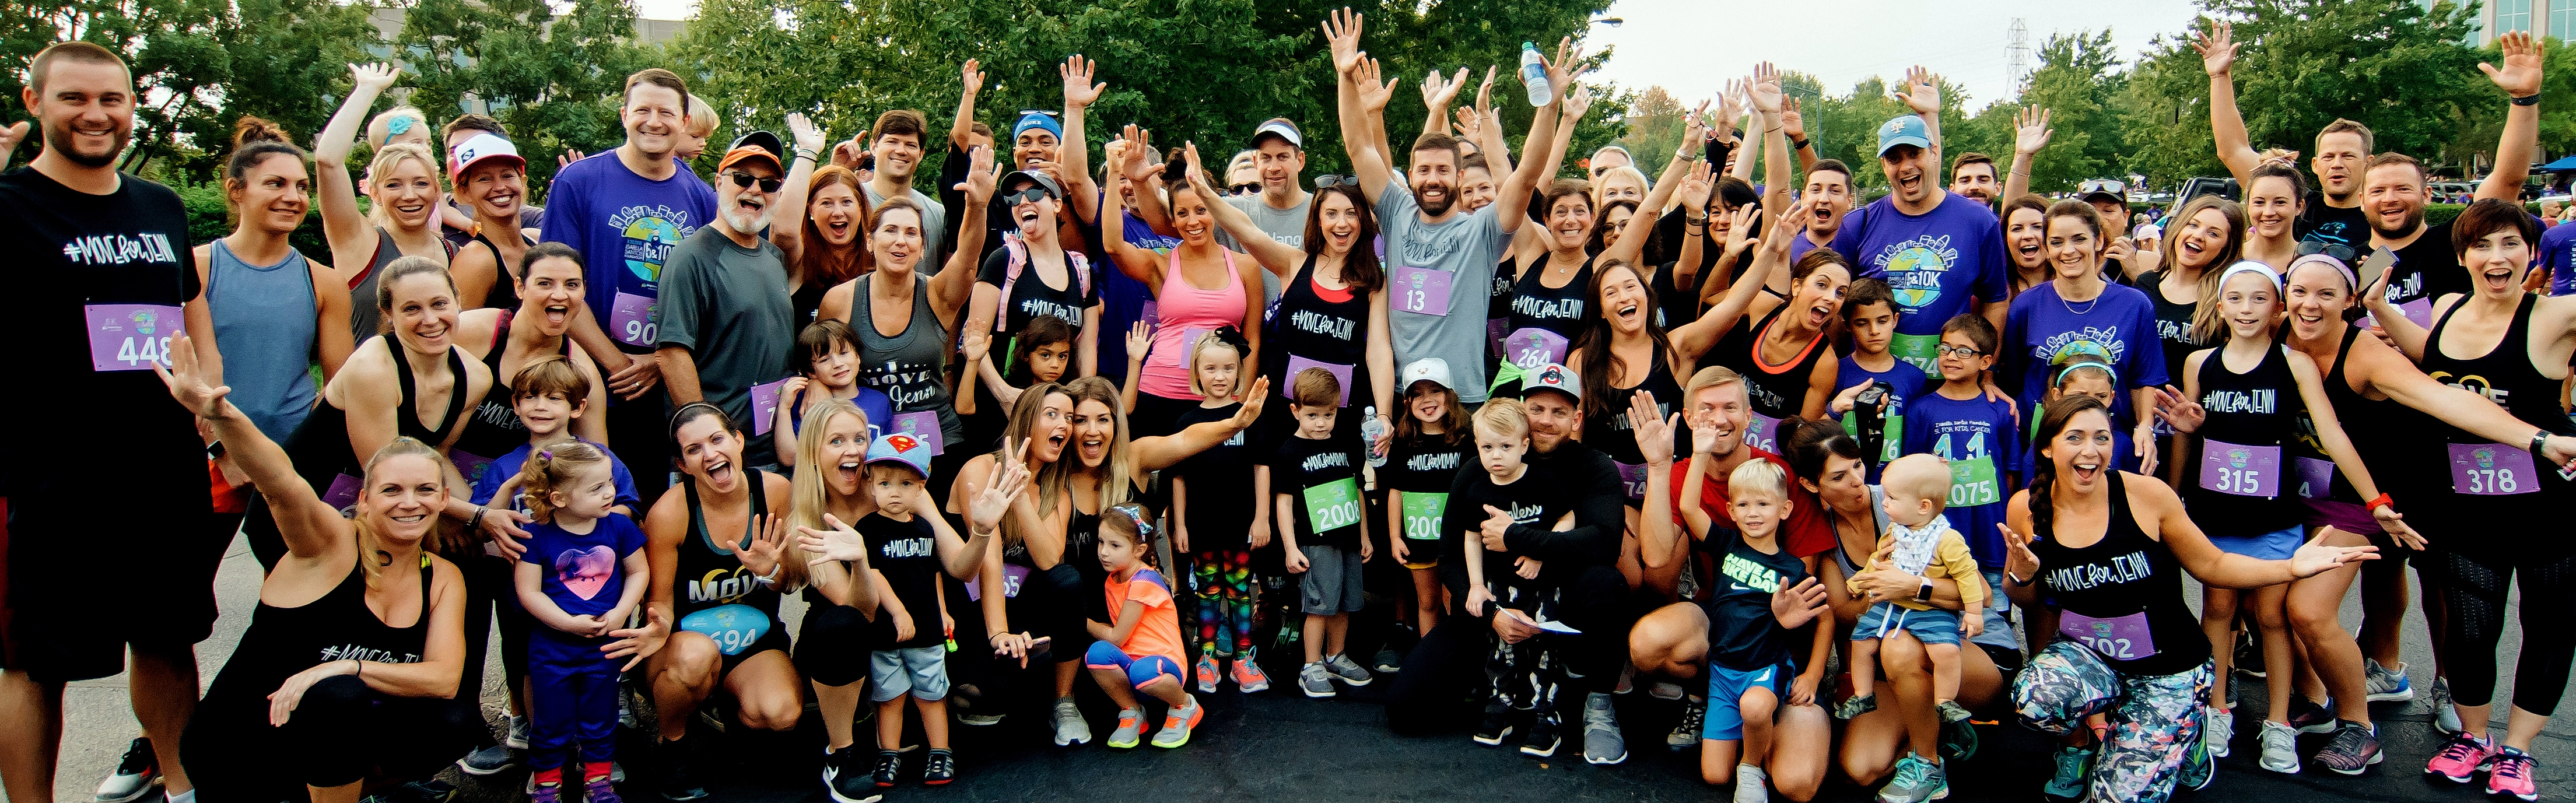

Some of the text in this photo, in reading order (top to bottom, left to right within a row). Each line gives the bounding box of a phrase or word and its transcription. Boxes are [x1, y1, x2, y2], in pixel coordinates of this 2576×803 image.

[1406, 289, 1425, 311] 13
[1512, 294, 1583, 320] #MOVEforJENN
[626, 320, 657, 345] 90
[1291, 309, 1356, 341] #MOVEforJENN
[117, 336, 173, 366] 448
[1517, 348, 1551, 369] 264
[861, 370, 931, 385] MOVE
[889, 385, 935, 412] Jenn
[2203, 389, 2275, 413] #MOVEforJENN
[1970, 426, 1991, 434] CANCER
[1407, 452, 1461, 471] #MOVEforMOMMY
[1945, 480, 1993, 506] 075
[2216, 467, 2259, 494] 315
[2466, 468, 2517, 493] 378
[1317, 499, 1360, 530] 2008
[1725, 553, 1776, 582] HAVE A
[2045, 550, 2151, 592] #MOVEforJENN
[1748, 573, 1781, 594] DAY
[2080, 636, 2135, 659] 702
